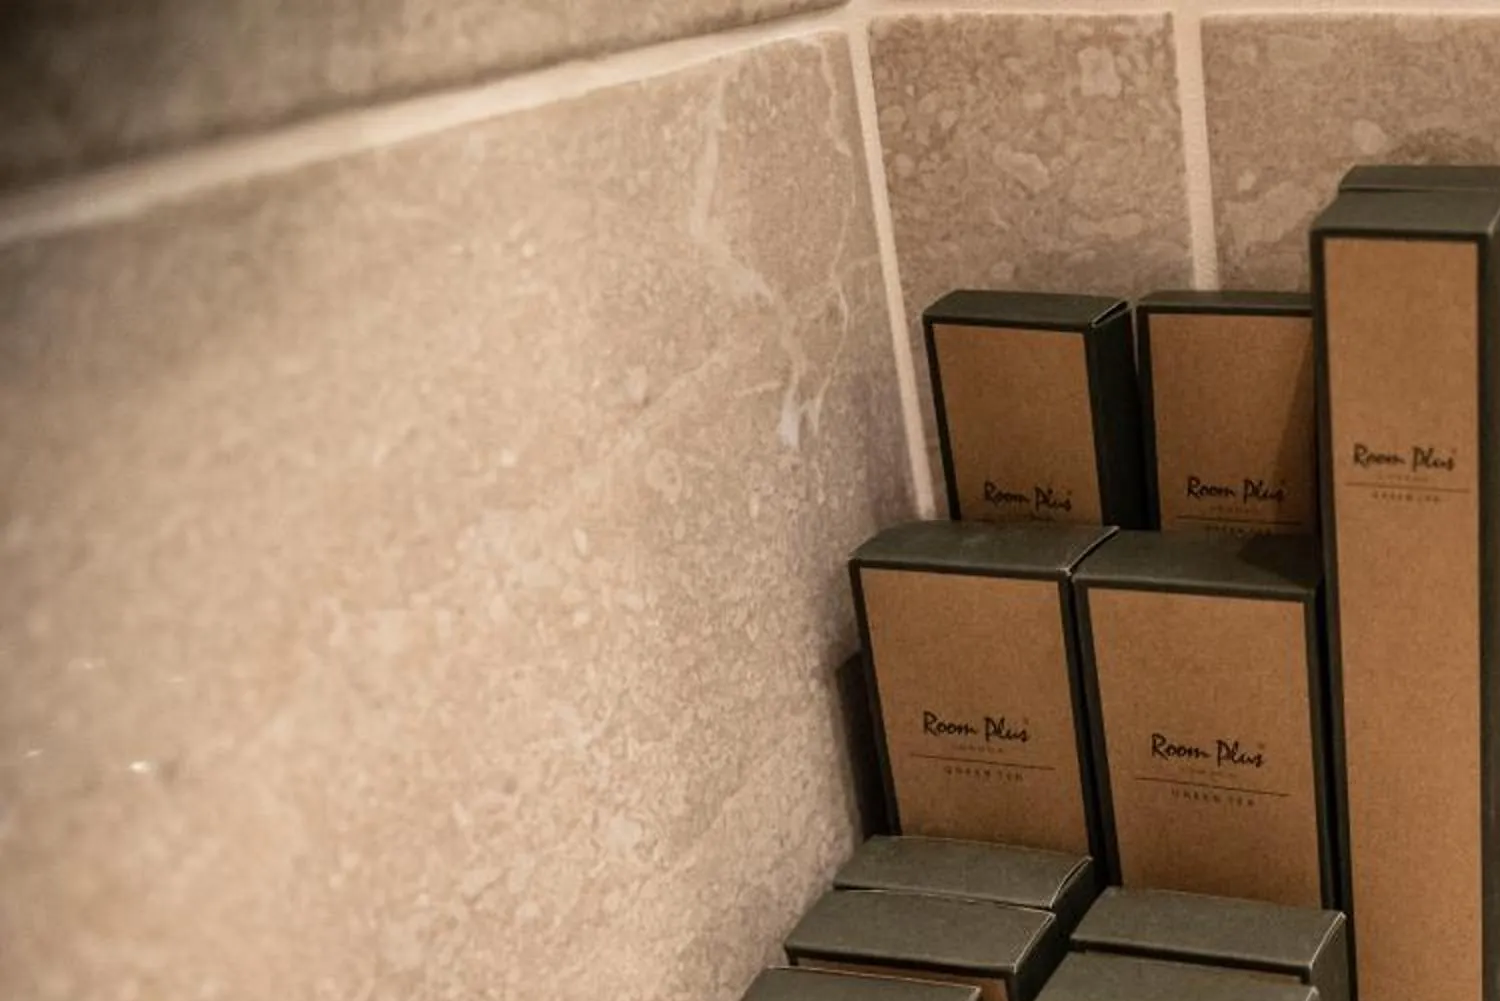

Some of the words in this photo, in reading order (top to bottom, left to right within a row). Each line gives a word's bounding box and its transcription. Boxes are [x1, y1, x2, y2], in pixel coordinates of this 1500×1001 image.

[1352, 442, 1406, 469] Room
[1412, 445, 1456, 472] Plus
[984, 480, 1030, 507] Room
[1187, 475, 1236, 501] Room
[1242, 477, 1285, 504] Plus
[923, 709, 977, 737] Room
[983, 715, 1028, 743] Plus
[1151, 732, 1211, 761] Room
[1215, 739, 1264, 768] Plus
